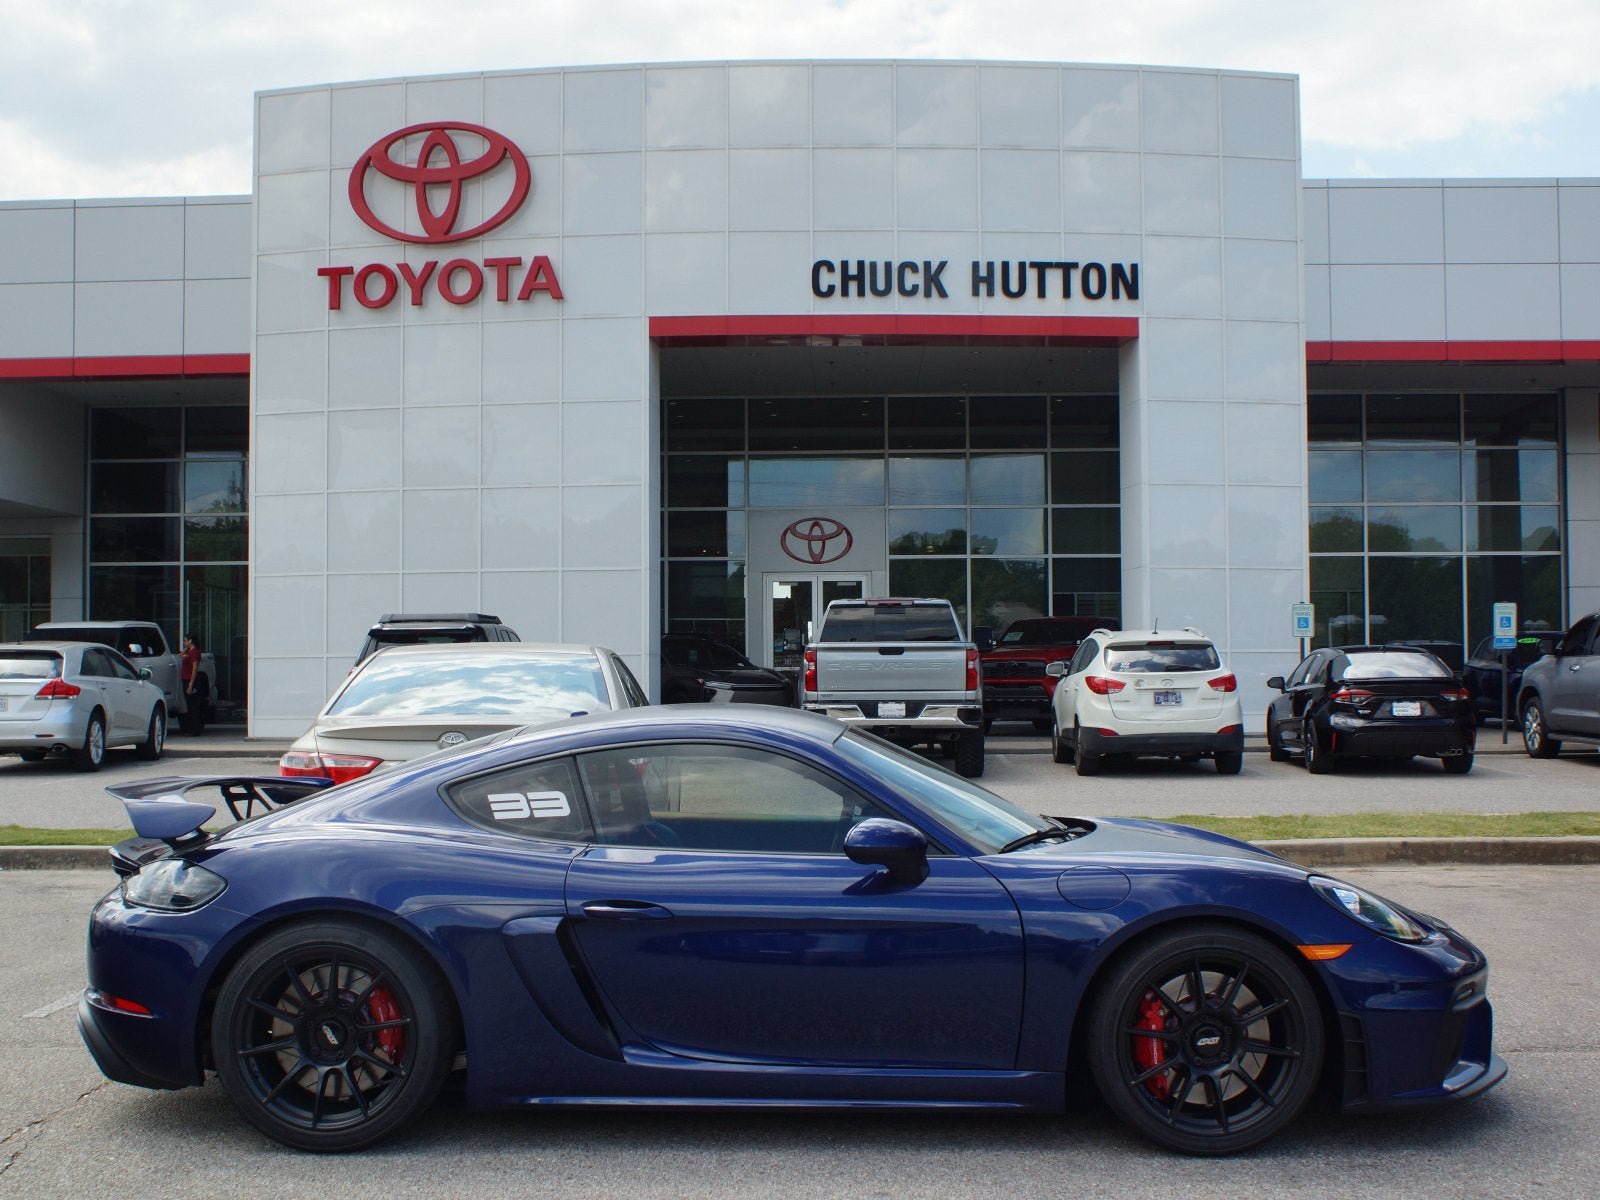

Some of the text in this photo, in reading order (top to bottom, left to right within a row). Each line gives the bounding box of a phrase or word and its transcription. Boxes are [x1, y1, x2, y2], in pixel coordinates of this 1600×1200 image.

[317, 255, 564, 311] TOYOTA
[811, 259, 1140, 301] CHUCK HUTTON
[487, 790, 571, 820] 33
